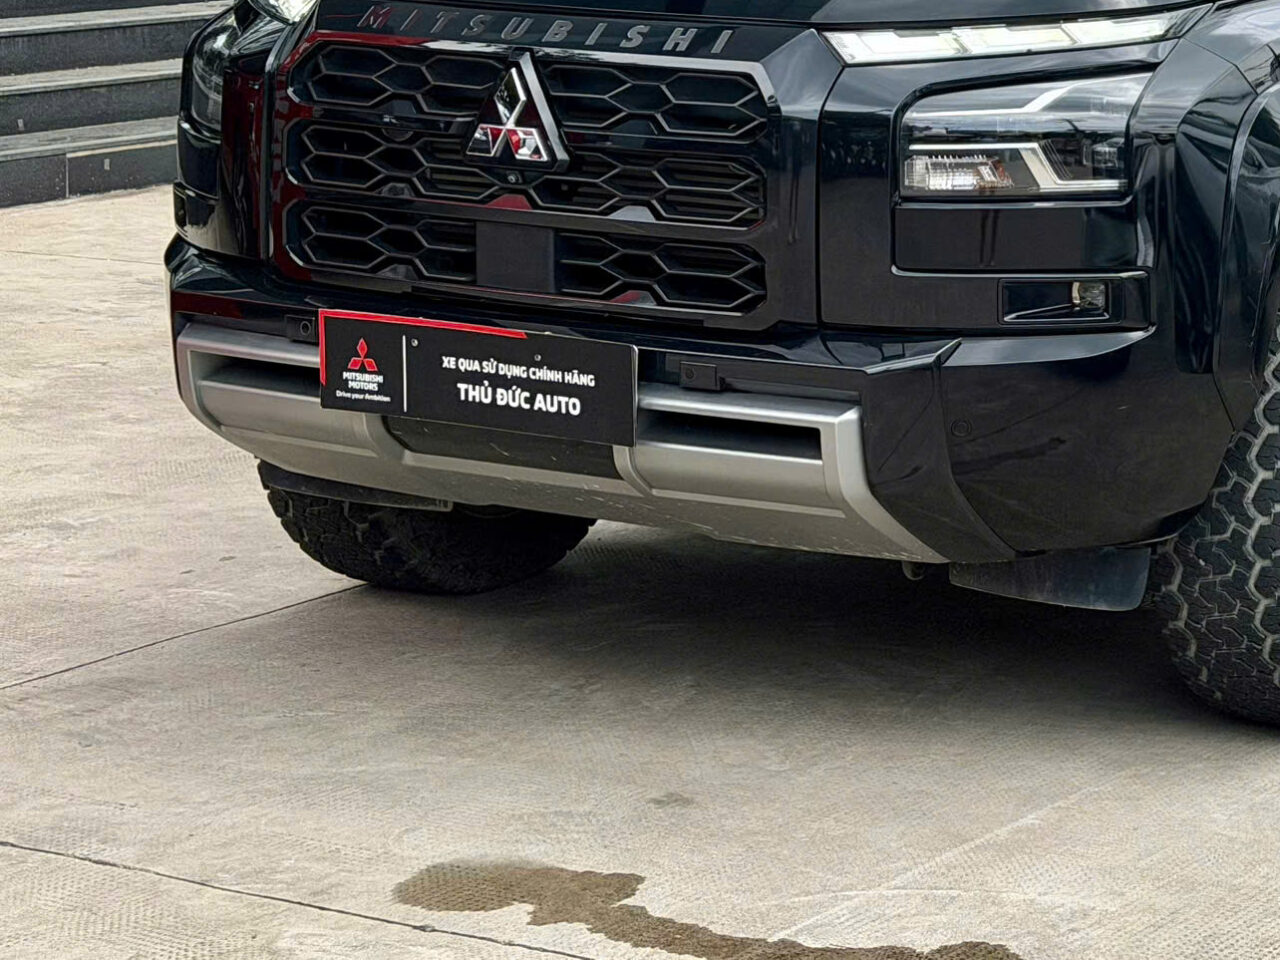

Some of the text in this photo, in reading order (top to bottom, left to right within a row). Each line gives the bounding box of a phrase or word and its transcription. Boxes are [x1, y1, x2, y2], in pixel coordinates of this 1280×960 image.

[357, 2, 736, 54] MITSUBISHI
[342, 371, 384, 384] MITSUBISHI
[441, 355, 595, 387] XE QUA SỬ DỤNG CHÍNH HÃNG
[335, 389, 351, 398] Drive
[364, 393, 391, 402] Ambition
[348, 380, 379, 391] MOTORS
[456, 380, 581, 416] THỦ ĐỨC AUTO
